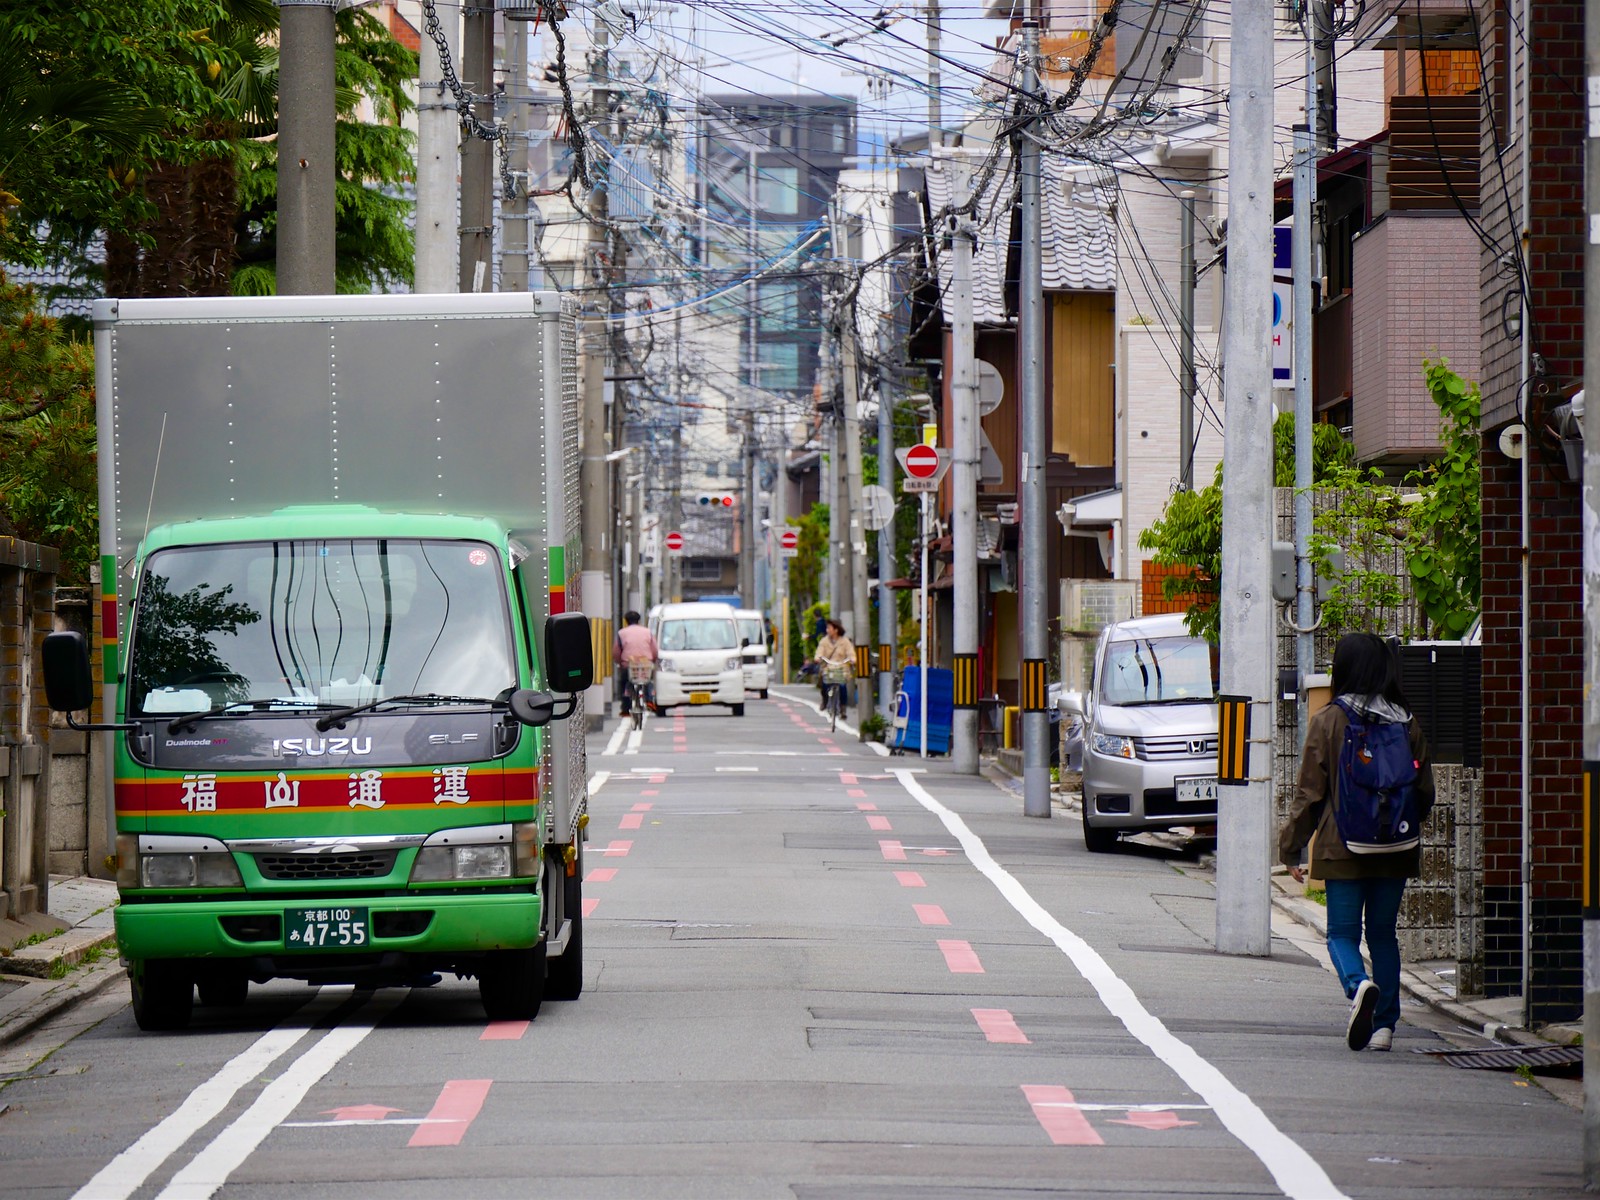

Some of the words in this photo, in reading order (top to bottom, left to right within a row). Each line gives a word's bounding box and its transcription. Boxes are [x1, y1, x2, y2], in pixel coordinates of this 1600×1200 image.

[165, 738, 211, 747] Dualmode
[272, 736, 373, 757] ISUZU
[428, 733, 479, 745] ELF
[181, 766, 470, 812] 福山通運
[289, 929, 301, 942] あ
[303, 922, 365, 946] 47-55
